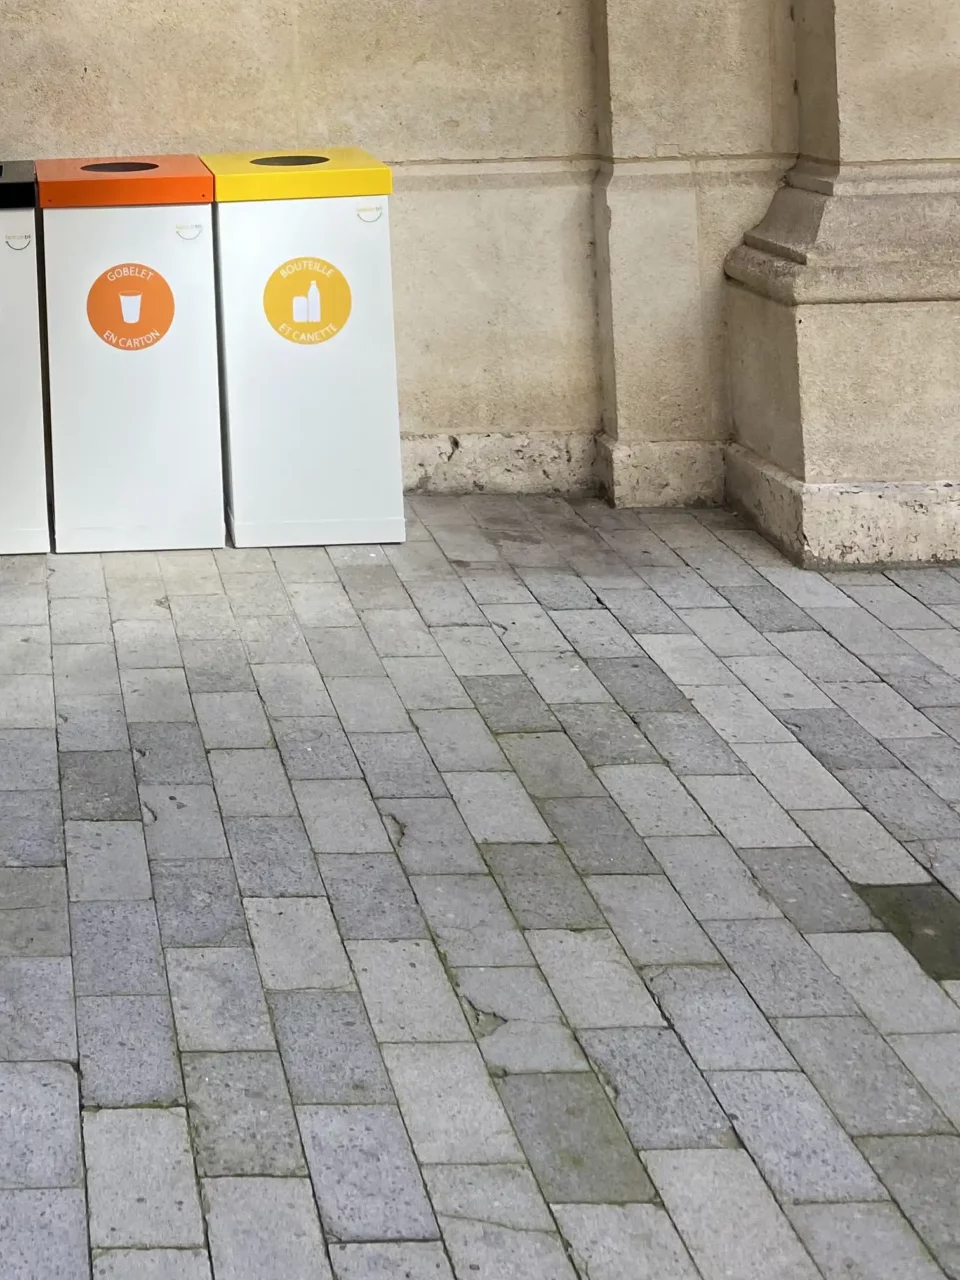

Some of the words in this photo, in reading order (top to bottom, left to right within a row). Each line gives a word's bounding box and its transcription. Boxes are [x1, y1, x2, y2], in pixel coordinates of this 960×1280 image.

[106, 266, 154, 282] GOBELET
[279, 260, 335, 279] BOUTEILLE
[103, 329, 118, 344] EN
[118, 328, 161, 348] CARTON
[278, 322, 292, 336] ET
[292, 322, 338, 342] CANETTE
